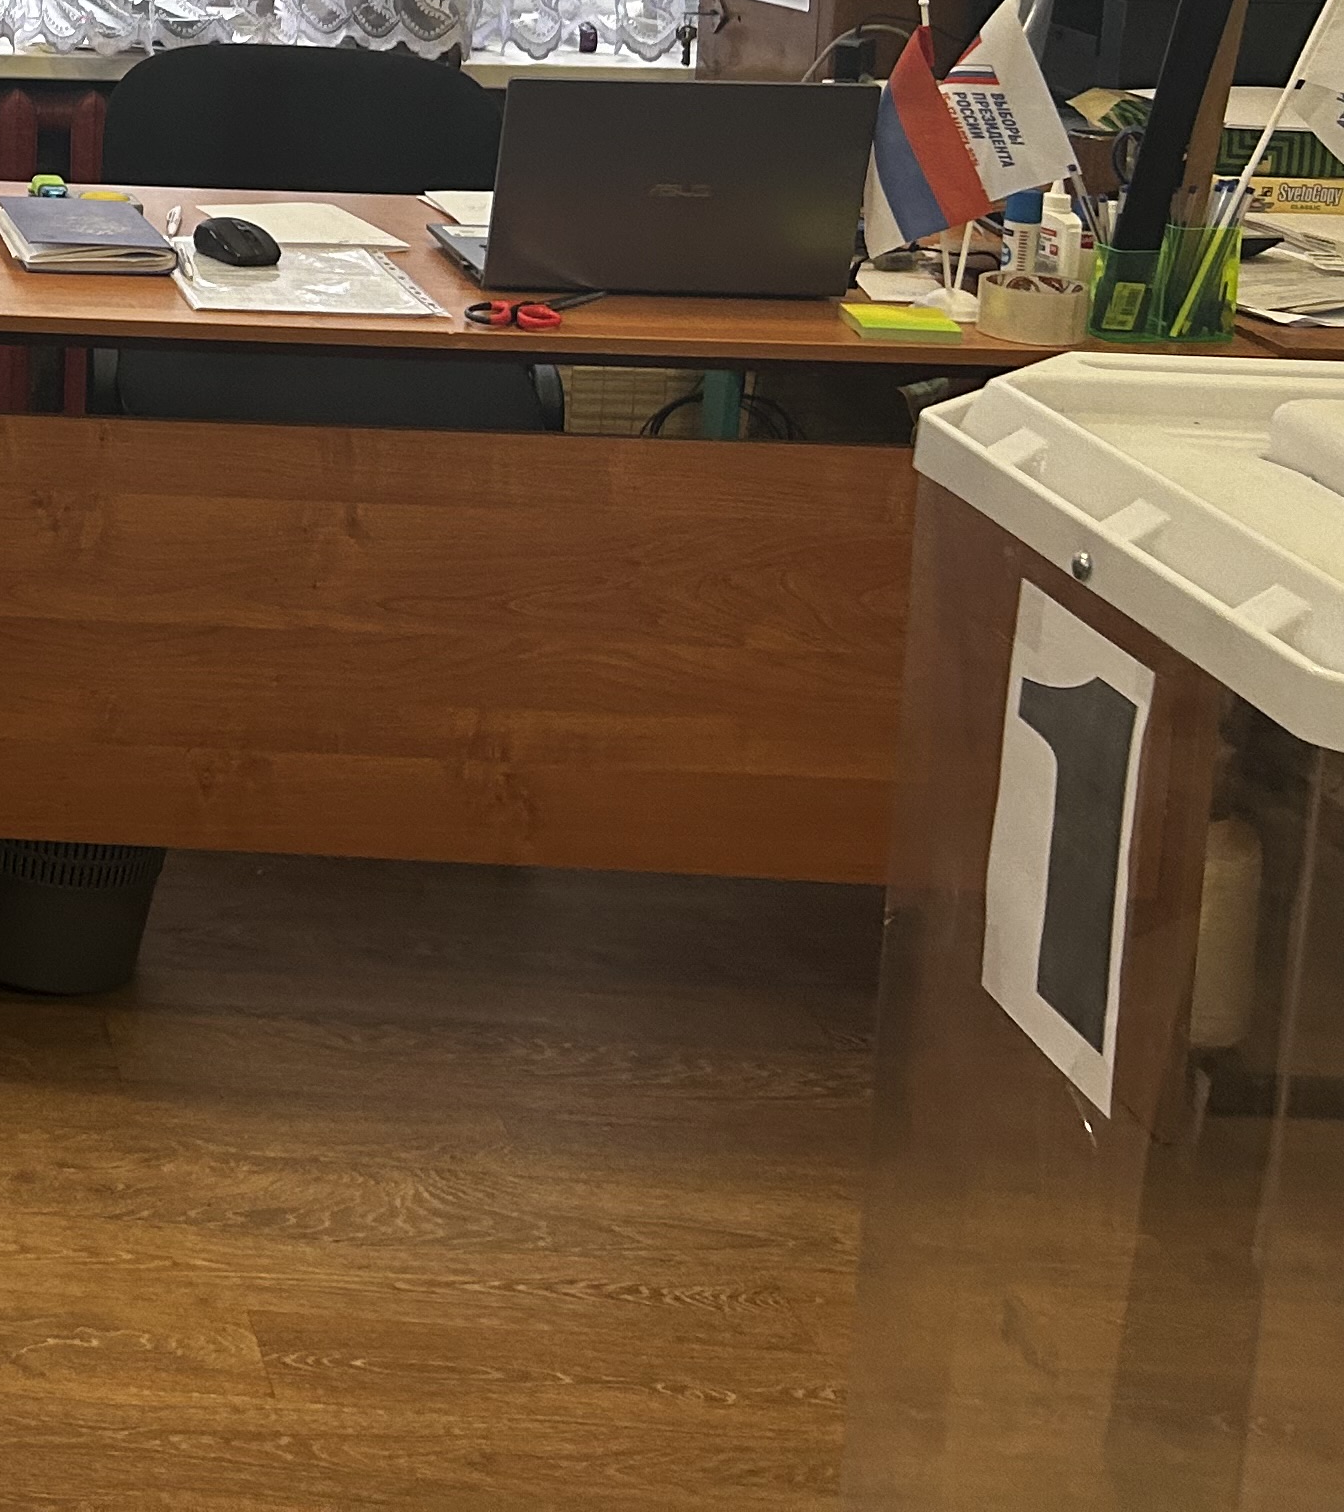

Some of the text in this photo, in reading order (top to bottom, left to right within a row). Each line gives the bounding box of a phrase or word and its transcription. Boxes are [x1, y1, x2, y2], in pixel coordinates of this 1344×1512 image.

[952, 91, 986, 140] РОССИИ
[970, 92, 1016, 168] ПРЕЗИДЕНТА
[990, 92, 1025, 146] ВЫБОРЫ
[1277, 182, 1343, 206] SvetoCopy
[1018, 675, 1139, 1057] 1
